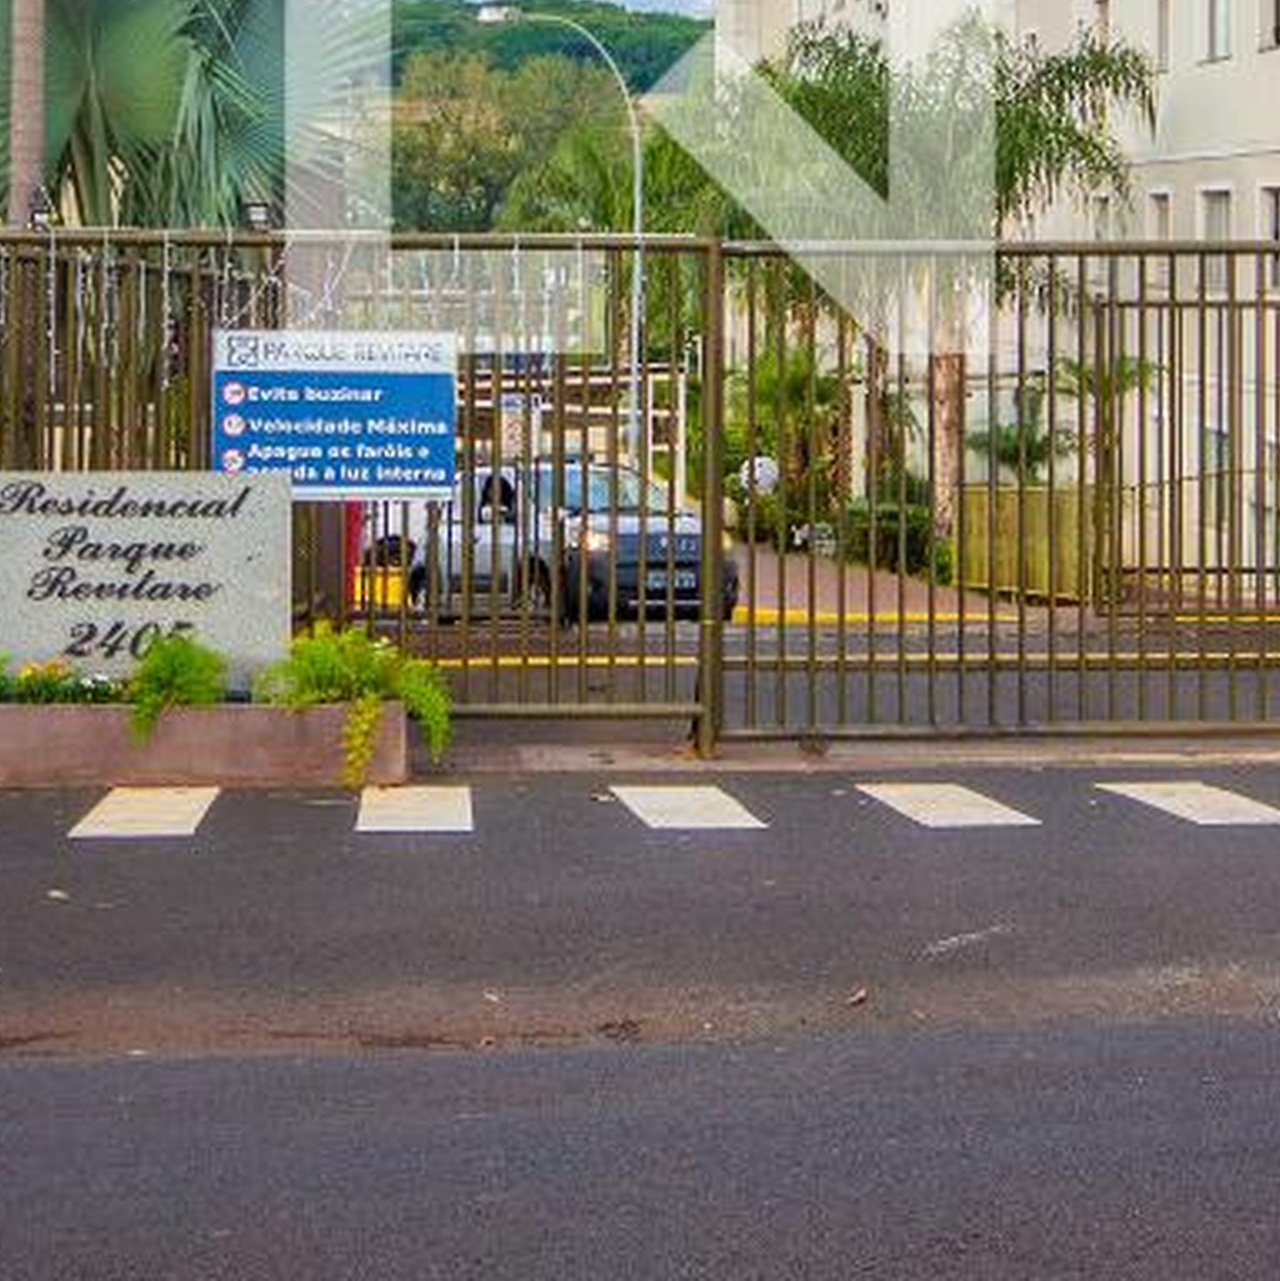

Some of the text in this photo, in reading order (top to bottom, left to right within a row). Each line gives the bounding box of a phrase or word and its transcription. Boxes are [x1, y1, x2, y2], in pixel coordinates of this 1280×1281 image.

[249, 418, 449, 435] Velocidade Máxima
[340, 464, 370, 480] luz
[376, 463, 447, 481] interna
[42, 526, 206, 575] Parque
[26, 567, 222, 602] Revitare
